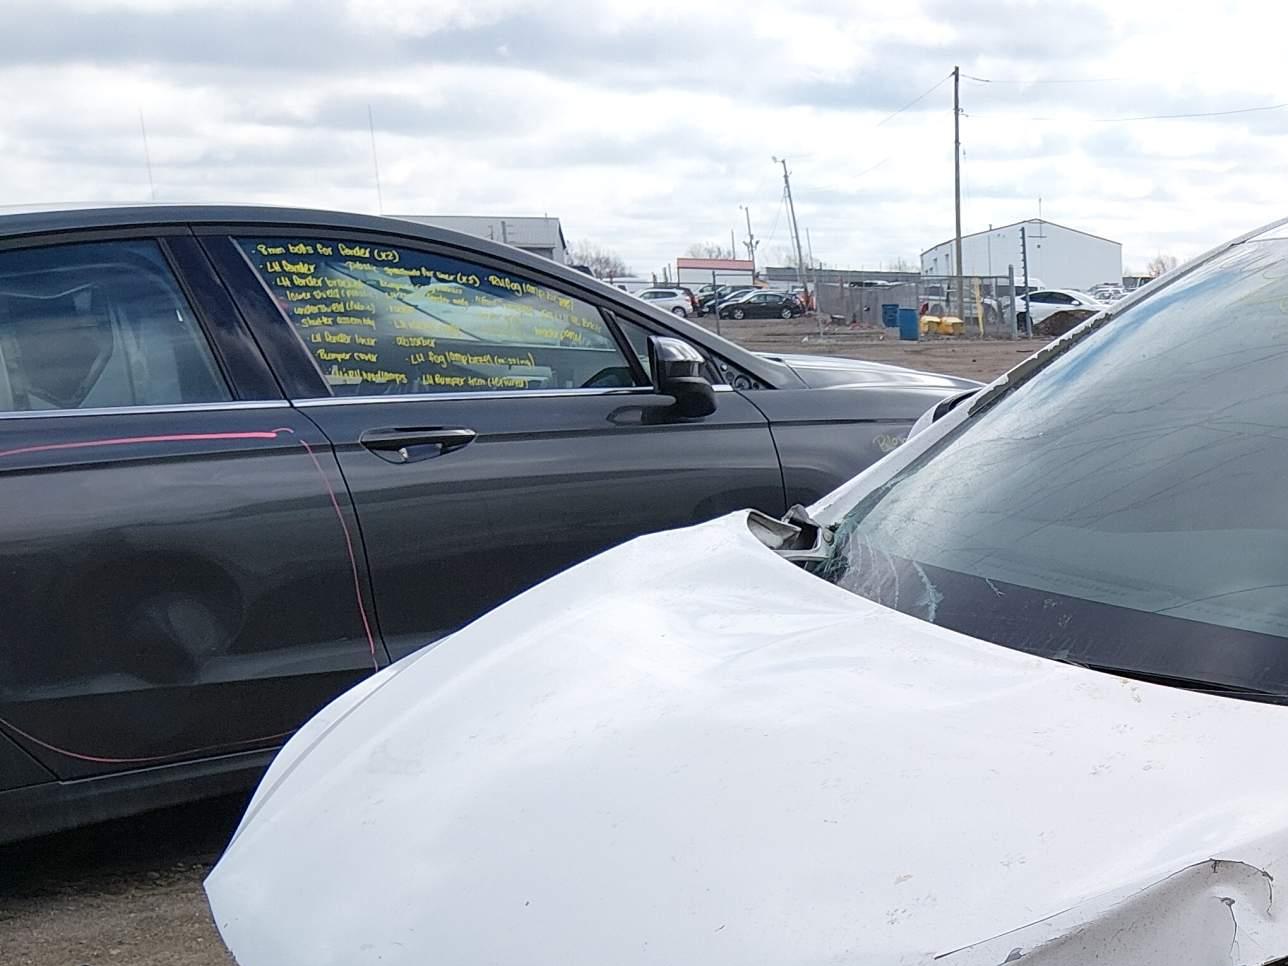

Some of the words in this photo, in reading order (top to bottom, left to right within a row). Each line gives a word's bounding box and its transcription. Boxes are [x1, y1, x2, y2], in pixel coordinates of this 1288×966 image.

[316, 243, 332, 255] for
[267, 261, 281, 272] LH
[276, 276, 291, 287] LH
[505, 277, 522, 296] fog
[311, 333, 322, 343] LH
[411, 353, 425, 364] LH
[428, 351, 446, 368] fog
[422, 374, 434, 385] LH
